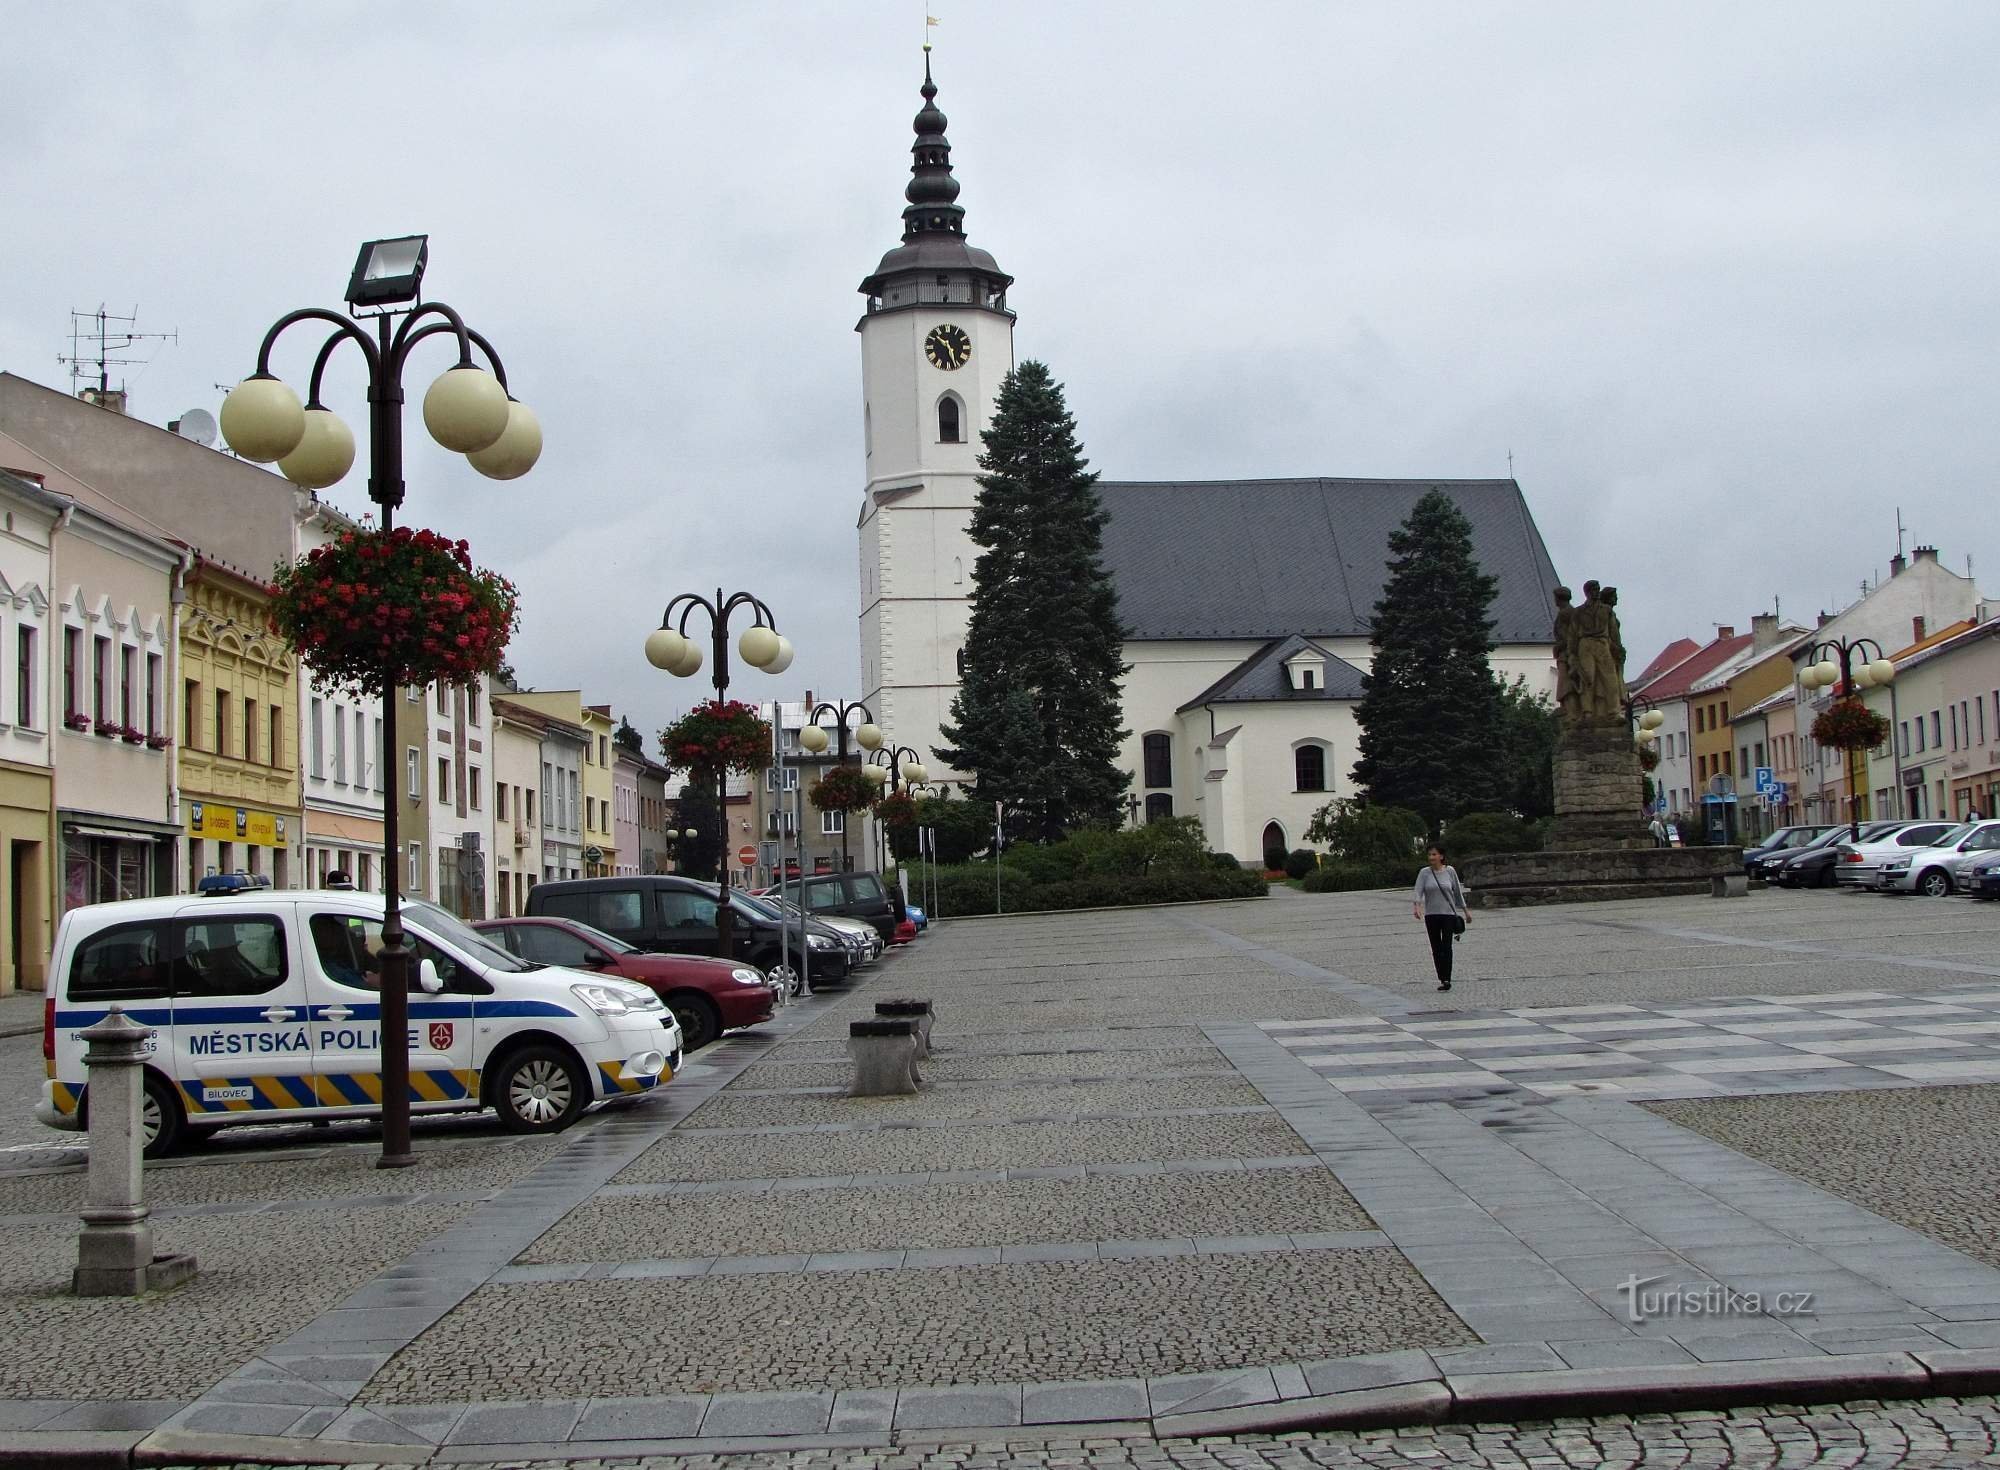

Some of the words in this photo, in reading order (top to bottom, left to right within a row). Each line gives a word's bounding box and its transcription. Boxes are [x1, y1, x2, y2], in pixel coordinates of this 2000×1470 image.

[1760, 771, 1768, 784] P
[192, 806, 202, 820] TOP
[237, 813, 246, 827] TOP
[276, 819, 284, 831] TOP
[190, 1028, 310, 1054] MĚSTSKÁ
[320, 1029, 419, 1050] POLIE
